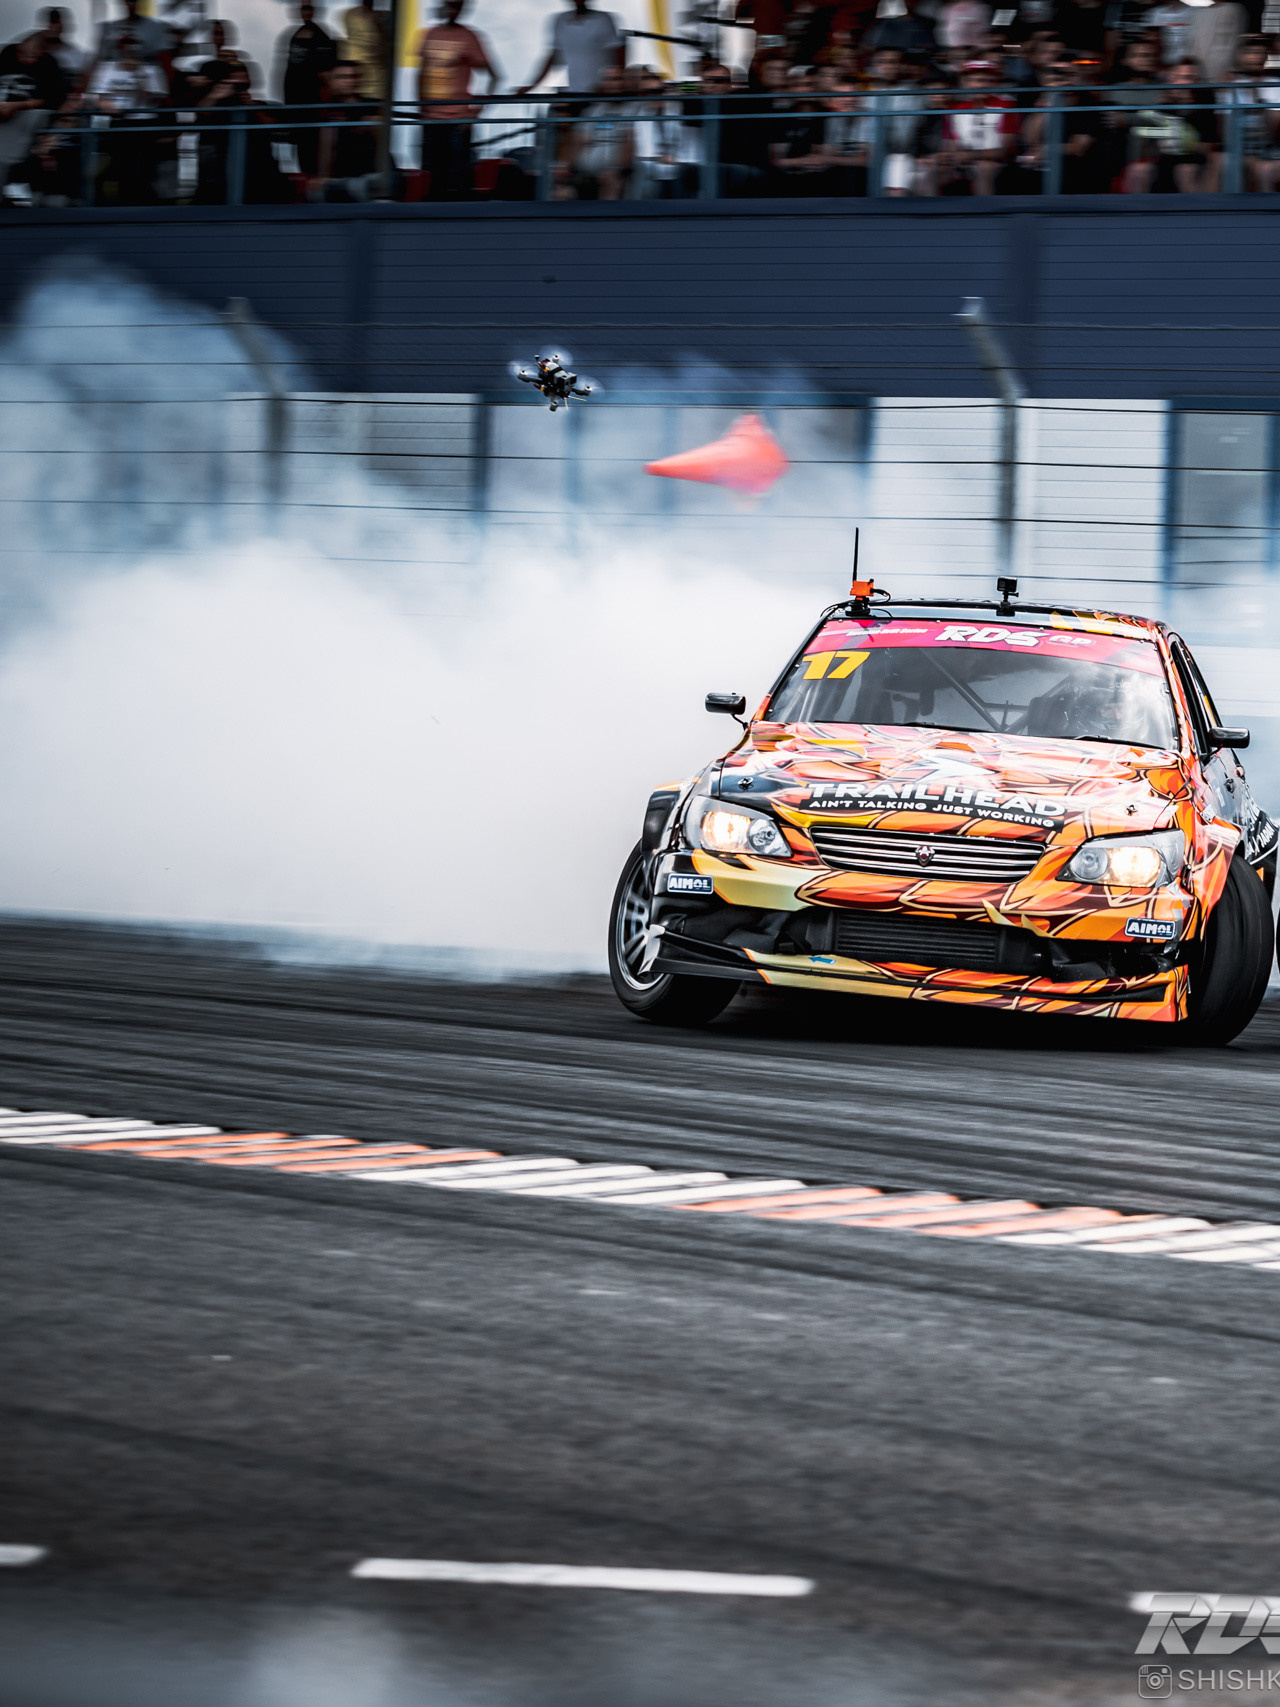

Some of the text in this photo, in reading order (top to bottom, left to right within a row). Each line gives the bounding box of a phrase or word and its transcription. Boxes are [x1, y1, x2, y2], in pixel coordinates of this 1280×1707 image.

[934, 625, 1048, 647] RDS
[802, 651, 870, 680] 17
[808, 783, 1067, 816] TRAILHEAD
[809, 800, 1056, 828] AIN'T TALKING JUST WORKING
[1127, 922, 1173, 935] AIMOL
